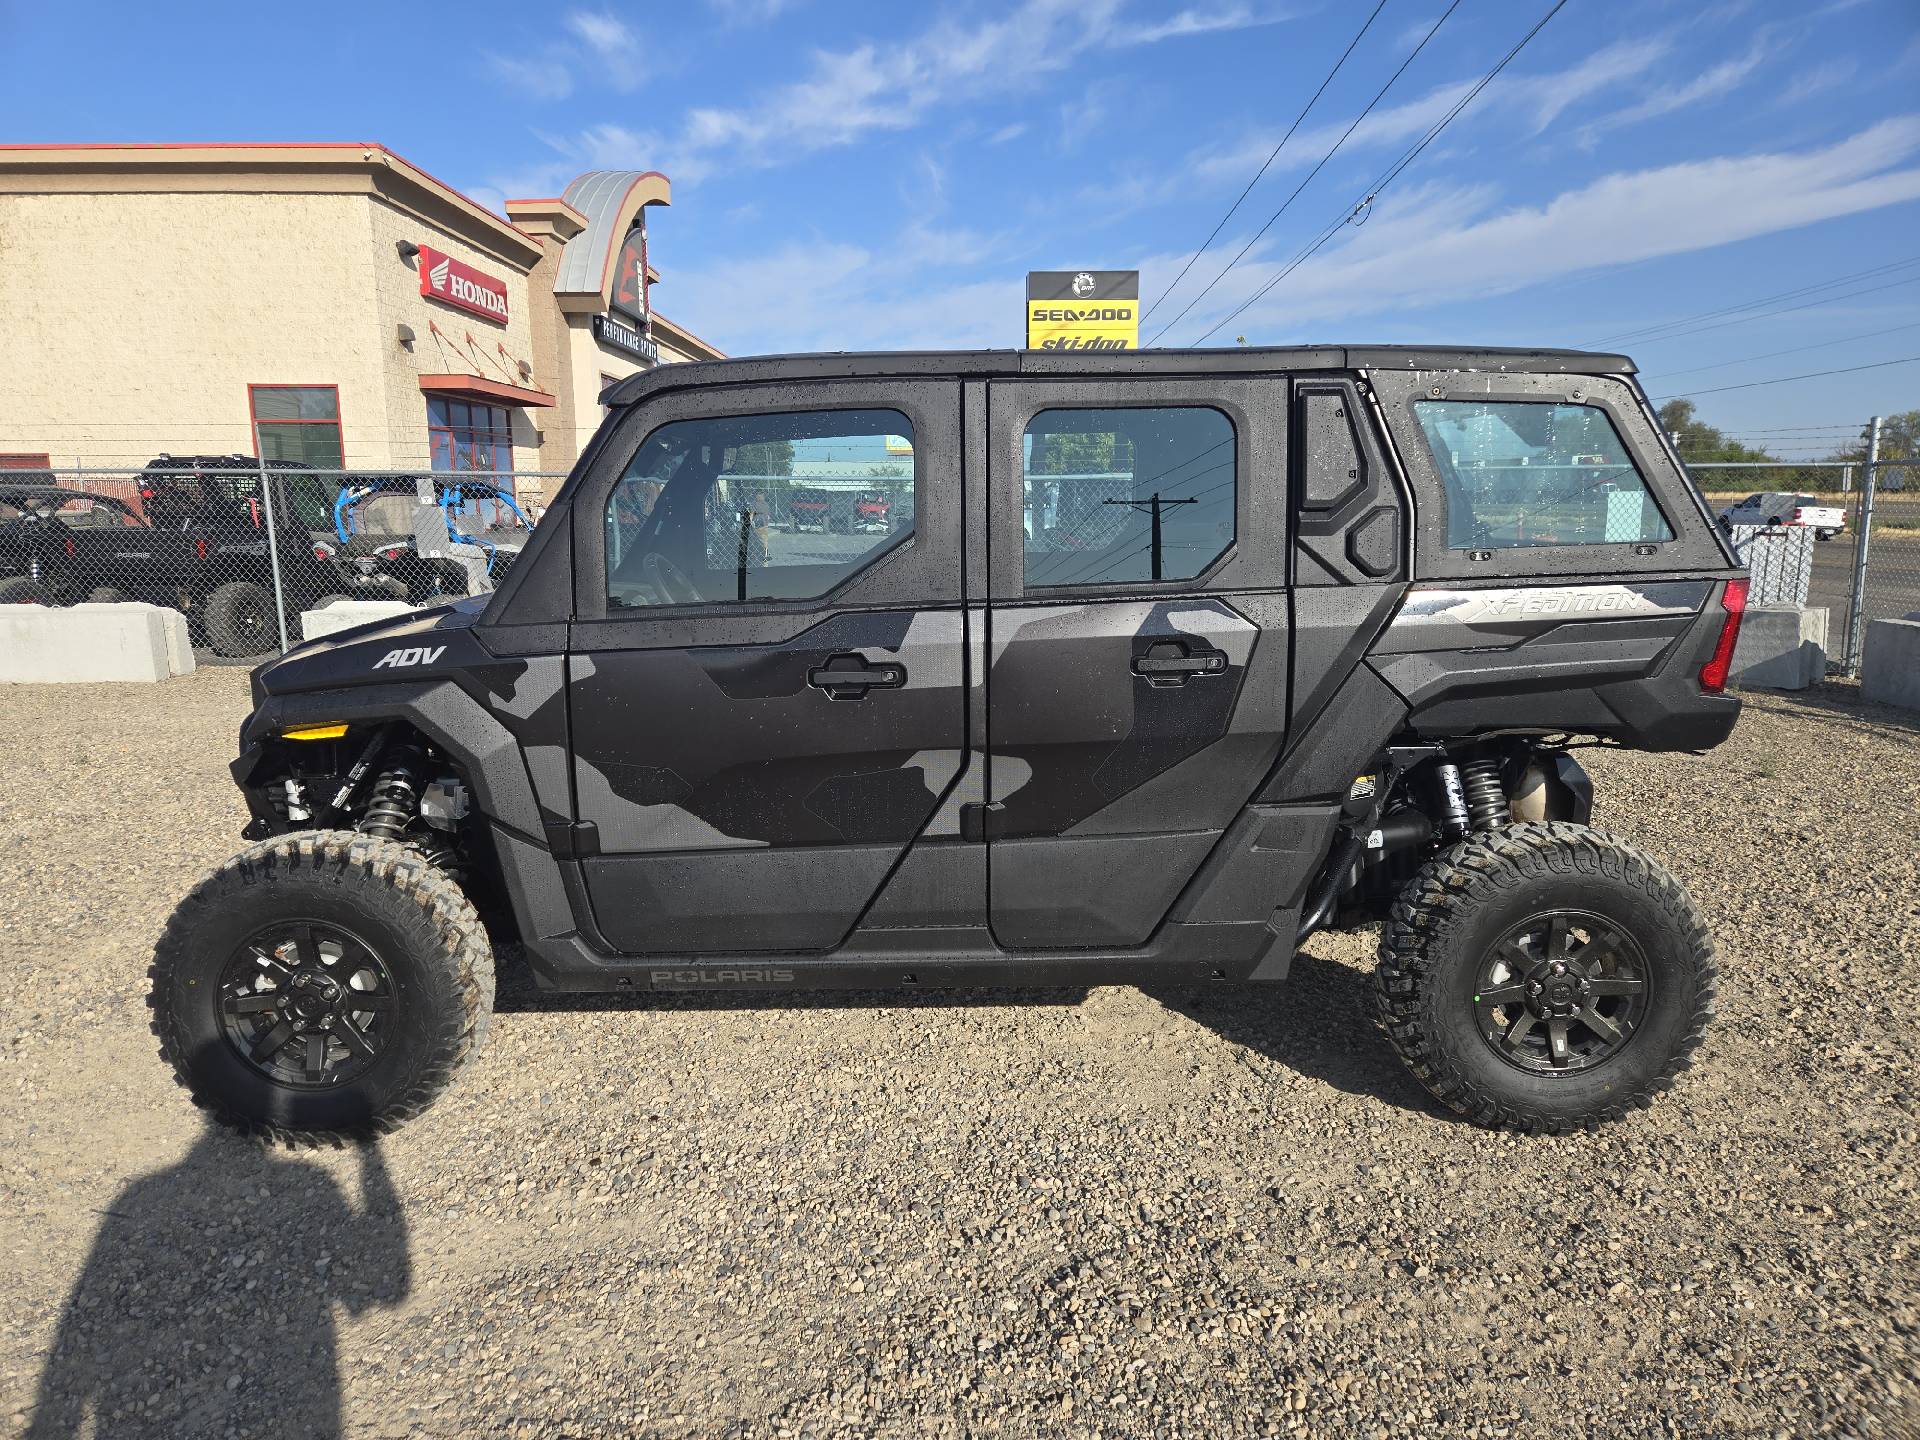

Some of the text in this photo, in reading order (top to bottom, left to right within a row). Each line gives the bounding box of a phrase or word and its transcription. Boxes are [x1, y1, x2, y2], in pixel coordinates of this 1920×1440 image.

[450, 273, 508, 316] HONDA
[1462, 592, 1644, 622] XPEDITION
[372, 645, 447, 669] ADV
[650, 969, 795, 983] POLARIS
